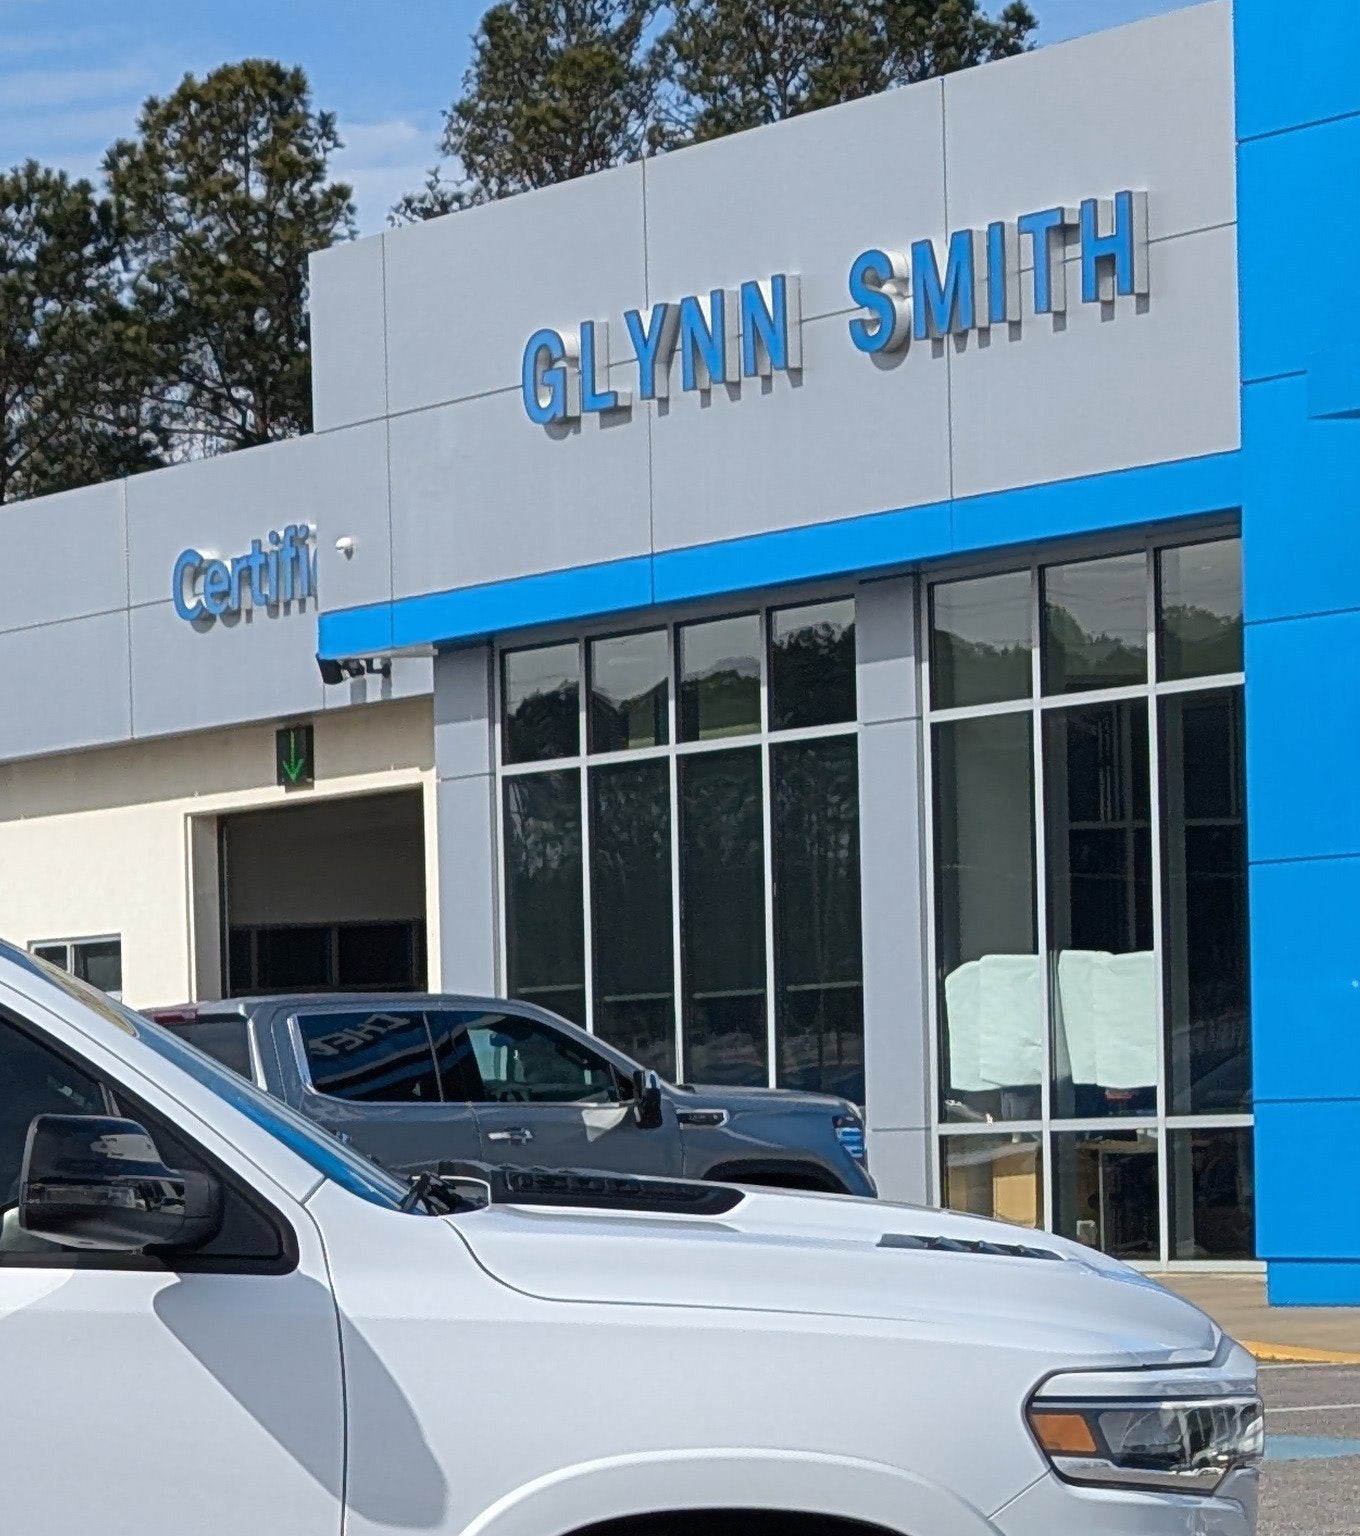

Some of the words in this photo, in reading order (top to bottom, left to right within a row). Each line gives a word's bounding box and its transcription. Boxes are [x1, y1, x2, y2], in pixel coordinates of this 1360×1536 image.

[522, 273, 792, 425] GLYNN
[849, 190, 1136, 354] SMITH
[173, 524, 318, 621] Certifi
